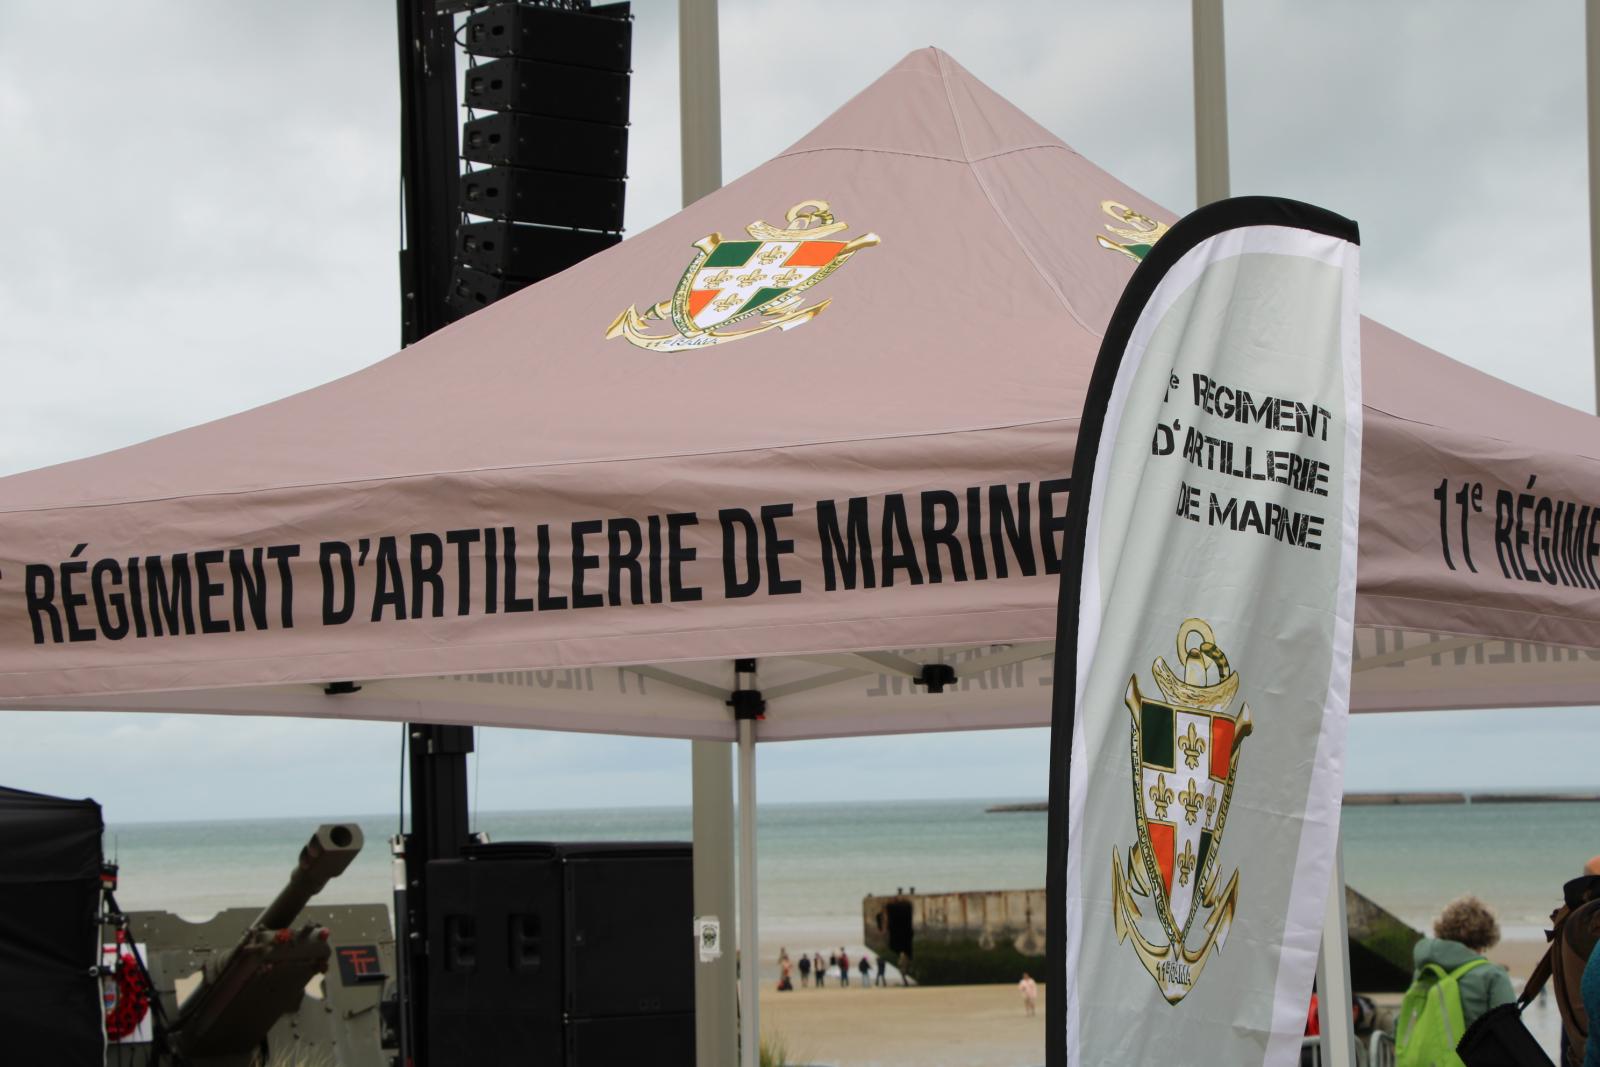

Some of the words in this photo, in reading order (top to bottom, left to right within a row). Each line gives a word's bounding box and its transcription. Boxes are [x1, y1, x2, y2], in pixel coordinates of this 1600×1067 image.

[1192, 373, 1331, 442] REGIMENT
[1176, 481, 1201, 522] DE
[1433, 478, 1483, 573] 11e
[25, 544, 300, 644] RÉGIMENT
[319, 512, 702, 625] D'ARTILLERIE
[719, 503, 802, 598] DE
[817, 478, 1071, 591] MARINE
